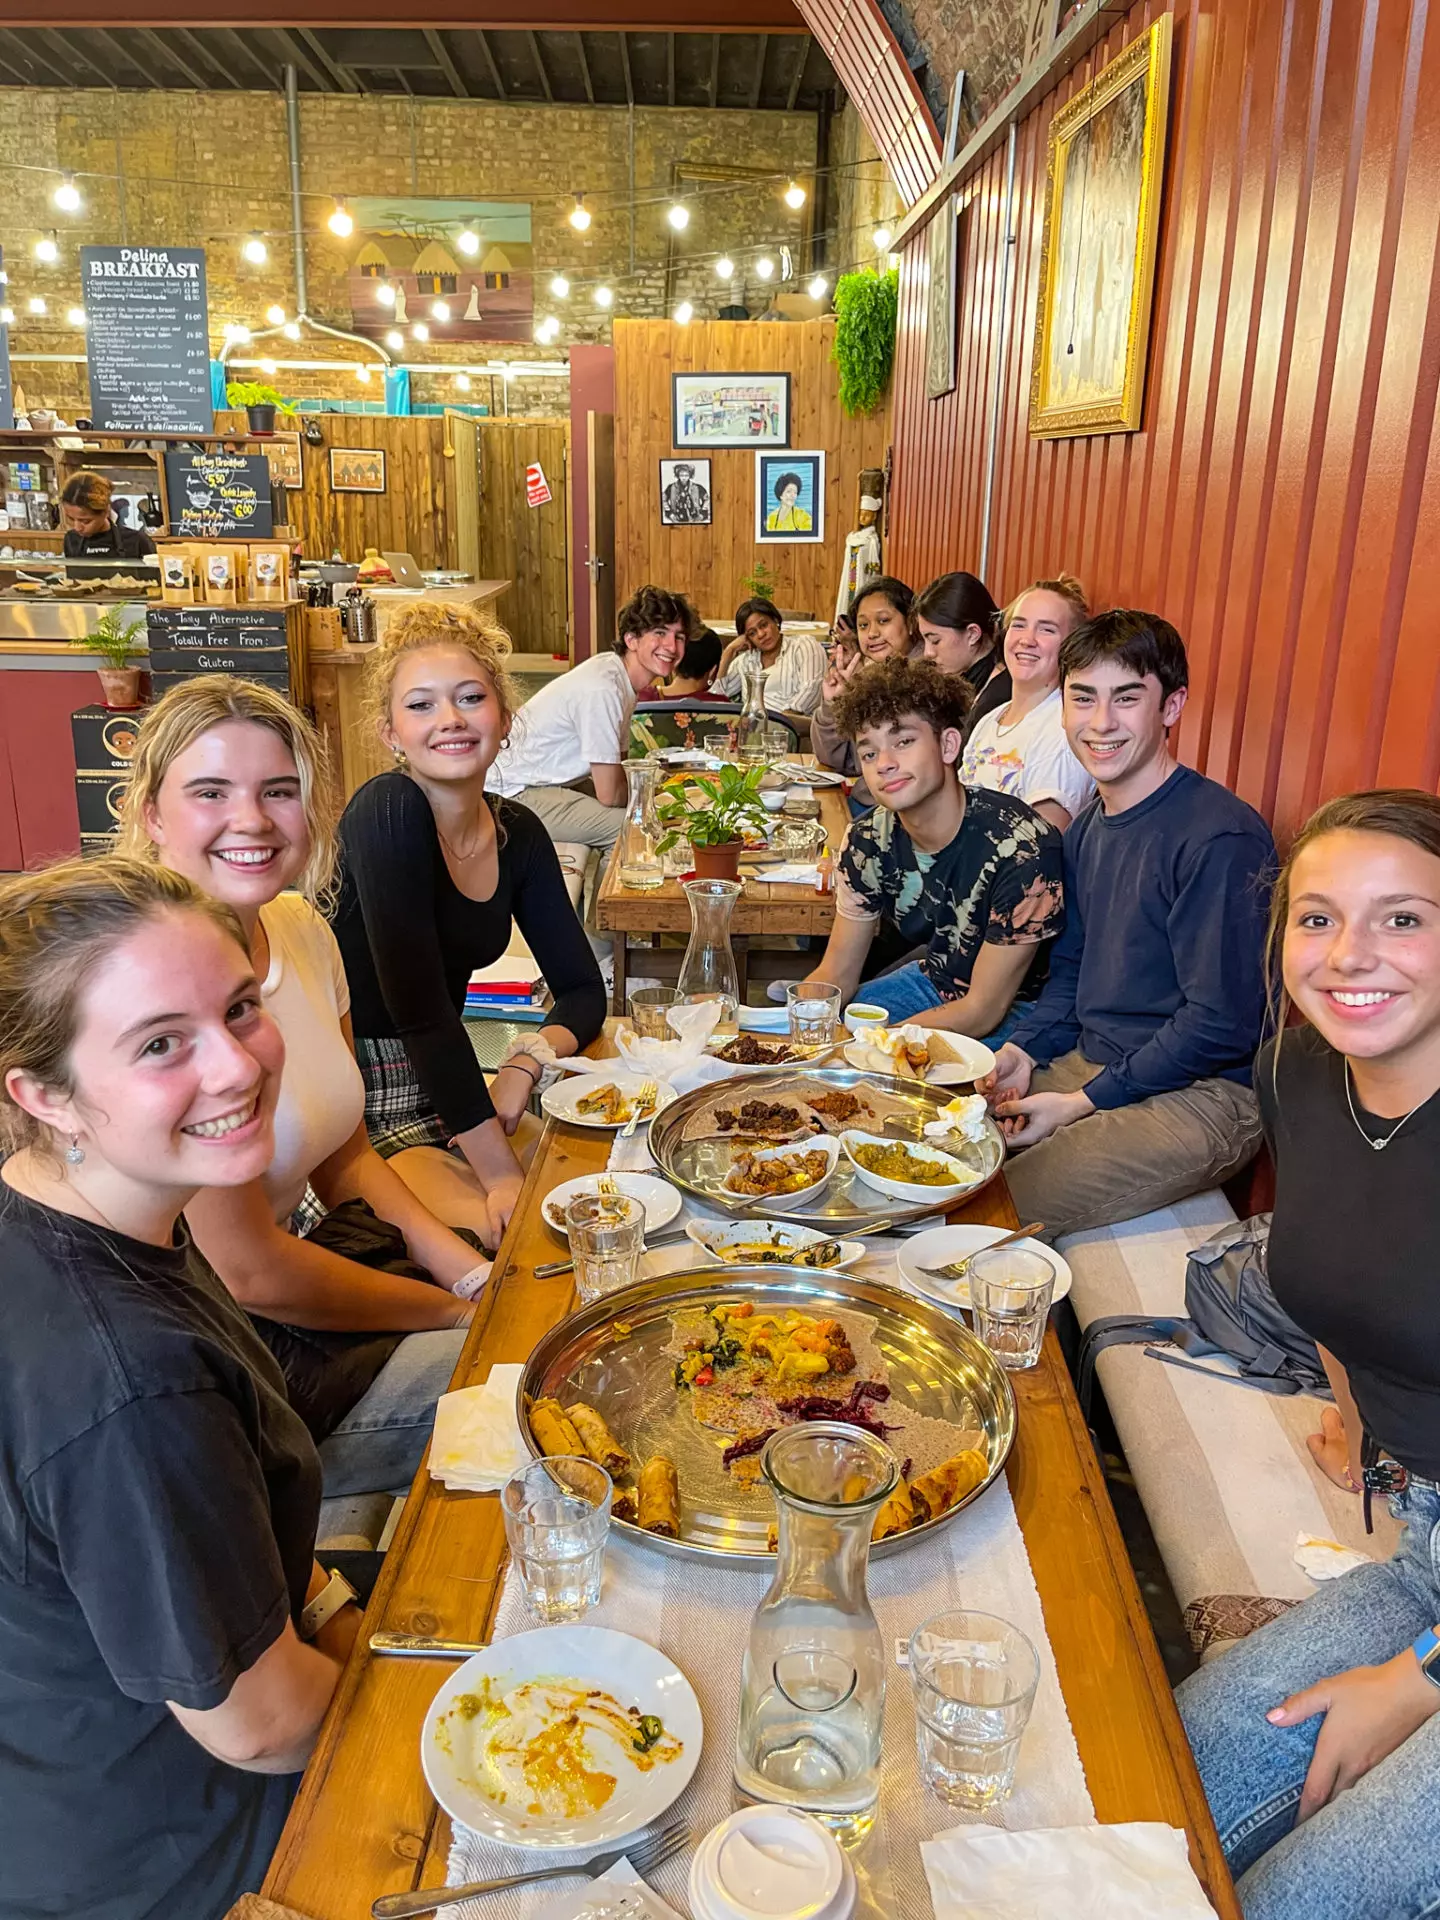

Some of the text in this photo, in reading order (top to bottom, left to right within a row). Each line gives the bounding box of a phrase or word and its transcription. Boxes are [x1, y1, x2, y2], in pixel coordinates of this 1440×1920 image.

[120, 248, 169, 263] Delina
[89, 261, 200, 278] BREAKFAST
[104, 421, 133, 430] Follow
[150, 613, 170, 625] The
[209, 612, 266, 625] Alternative
[167, 632, 203, 647] Totally
[207, 631, 229, 646] Free
[198, 655, 235, 668] Gluten
